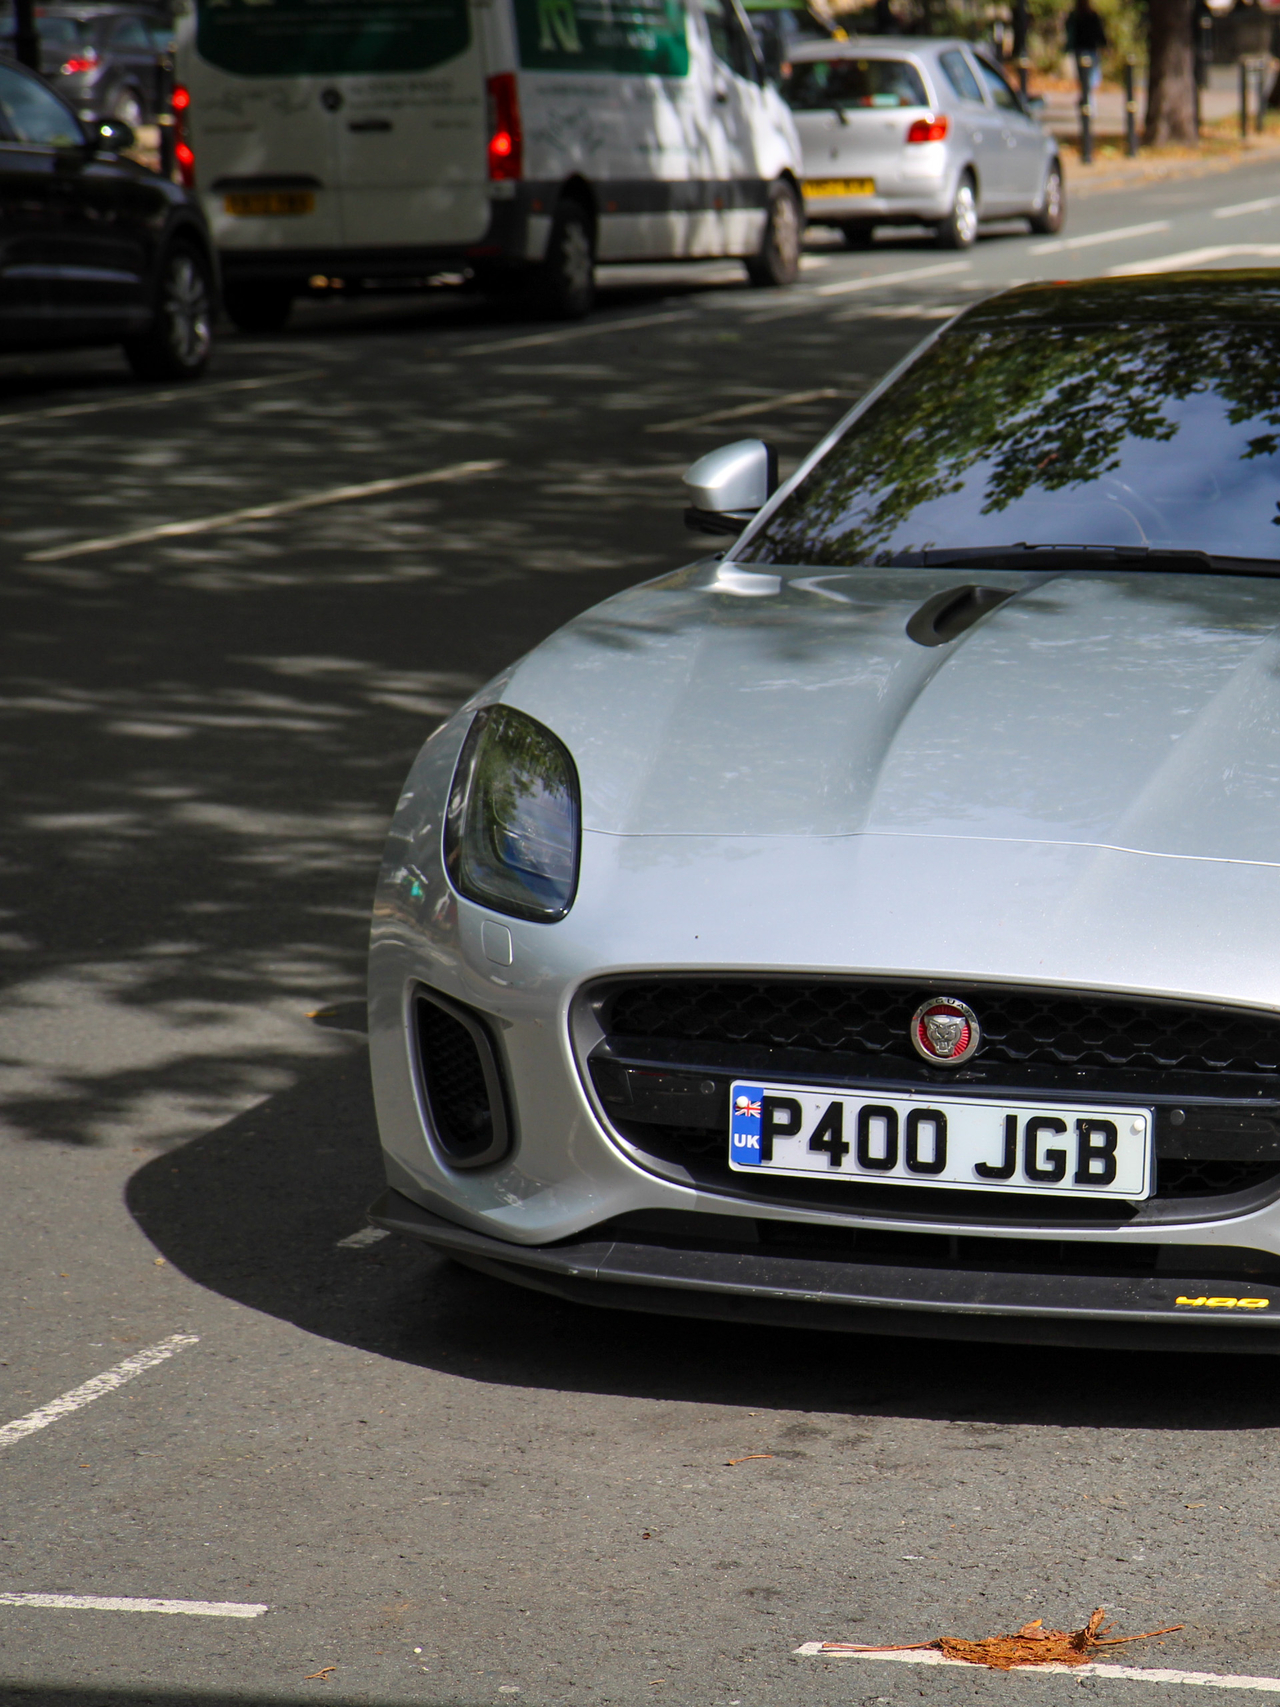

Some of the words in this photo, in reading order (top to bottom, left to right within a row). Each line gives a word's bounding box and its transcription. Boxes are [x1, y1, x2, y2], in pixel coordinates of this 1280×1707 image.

[733, 1133, 760, 1149] UK
[761, 1096, 948, 1174] P400
[974, 1114, 1118, 1185] JGB
[1175, 1296, 1270, 1309] 400
